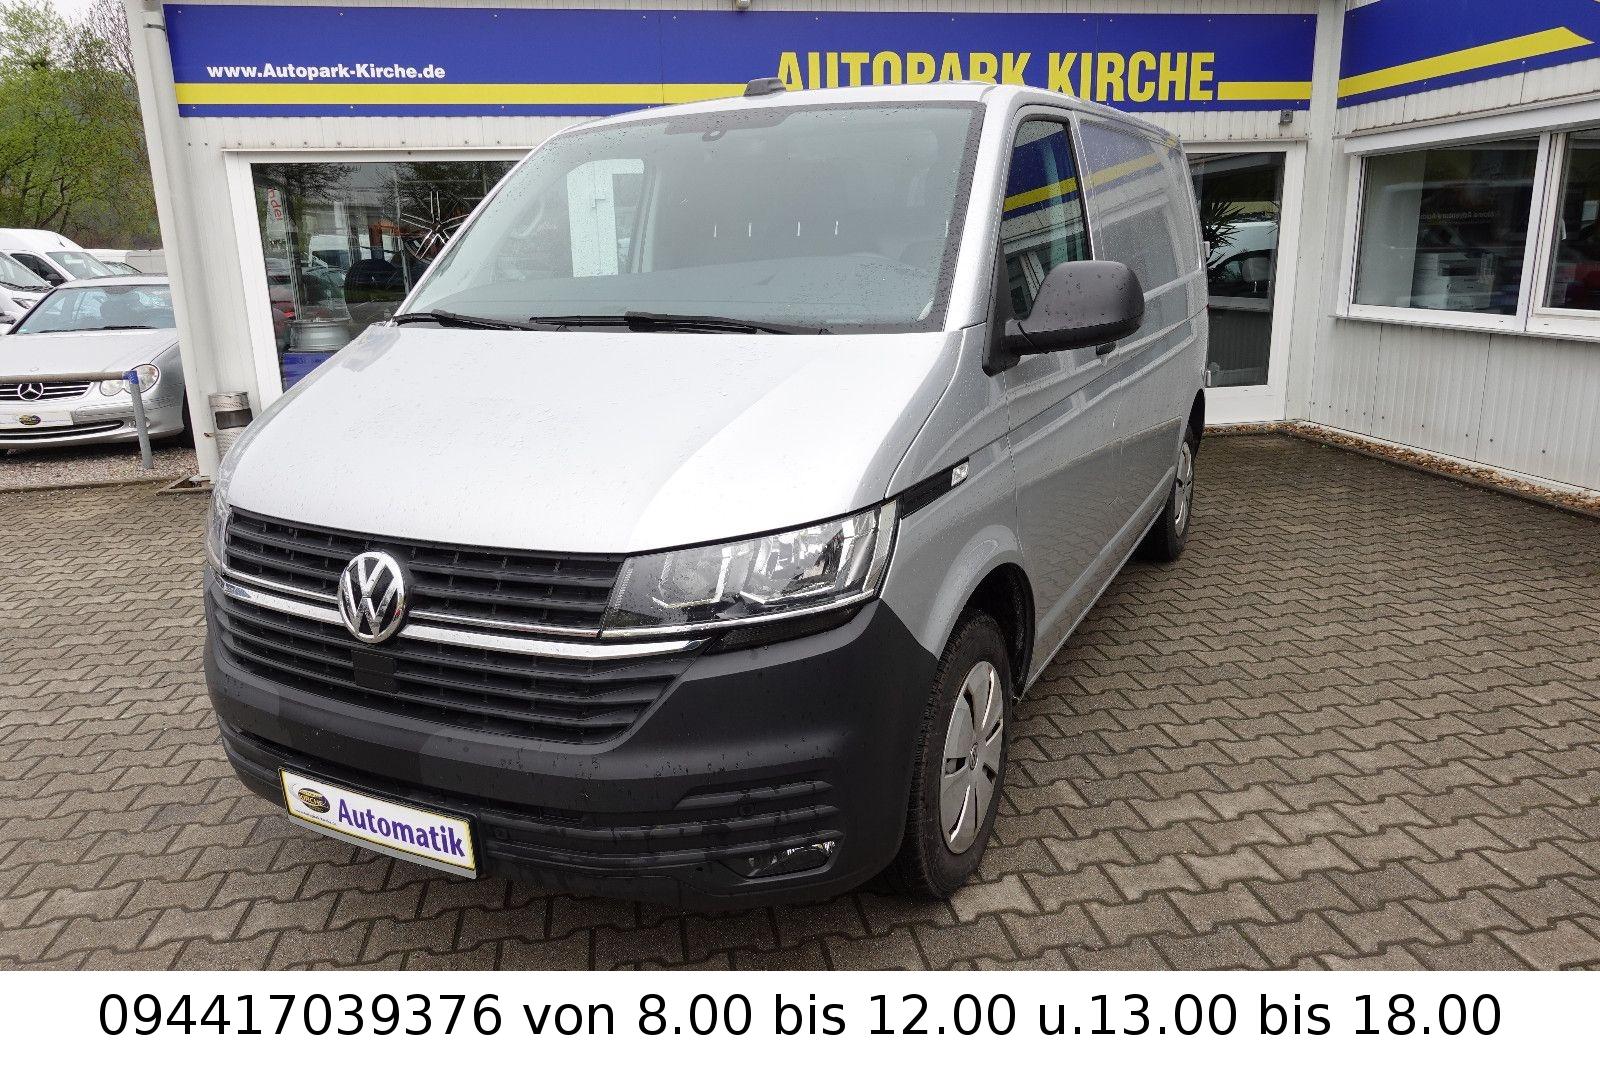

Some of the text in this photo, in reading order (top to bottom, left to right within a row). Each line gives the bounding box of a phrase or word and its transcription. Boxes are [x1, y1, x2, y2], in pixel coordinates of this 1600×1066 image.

[206, 63, 446, 81] www.Autopark-Kirche.de
[777, 50, 1215, 102] AUTOPARK KIRCHE
[338, 798, 466, 857] Automatik
